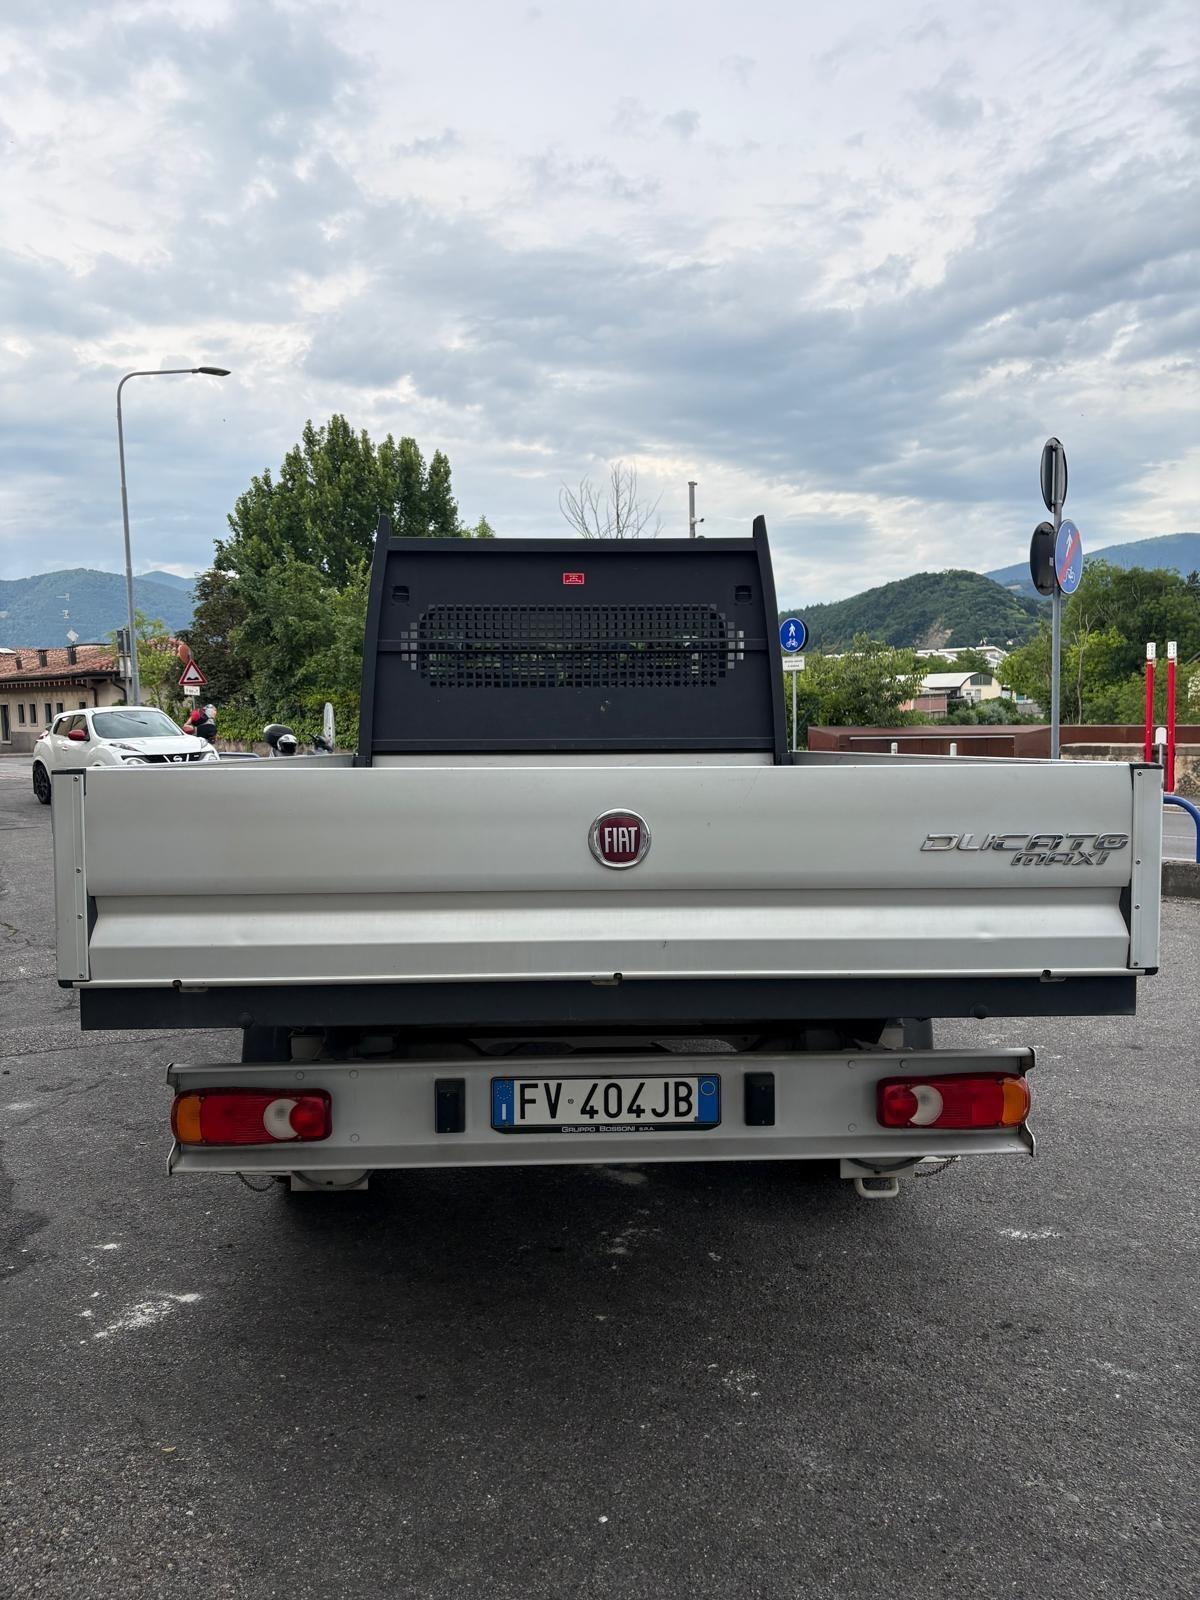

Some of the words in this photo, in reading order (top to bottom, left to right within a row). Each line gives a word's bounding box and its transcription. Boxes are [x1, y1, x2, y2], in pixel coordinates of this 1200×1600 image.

[604, 827, 637, 853] FIAT
[920, 833, 1129, 851] DUCATO
[1010, 850, 1111, 866] MAXI
[519, 1082, 562, 1120] FV
[580, 1081, 693, 1119] 404JB
